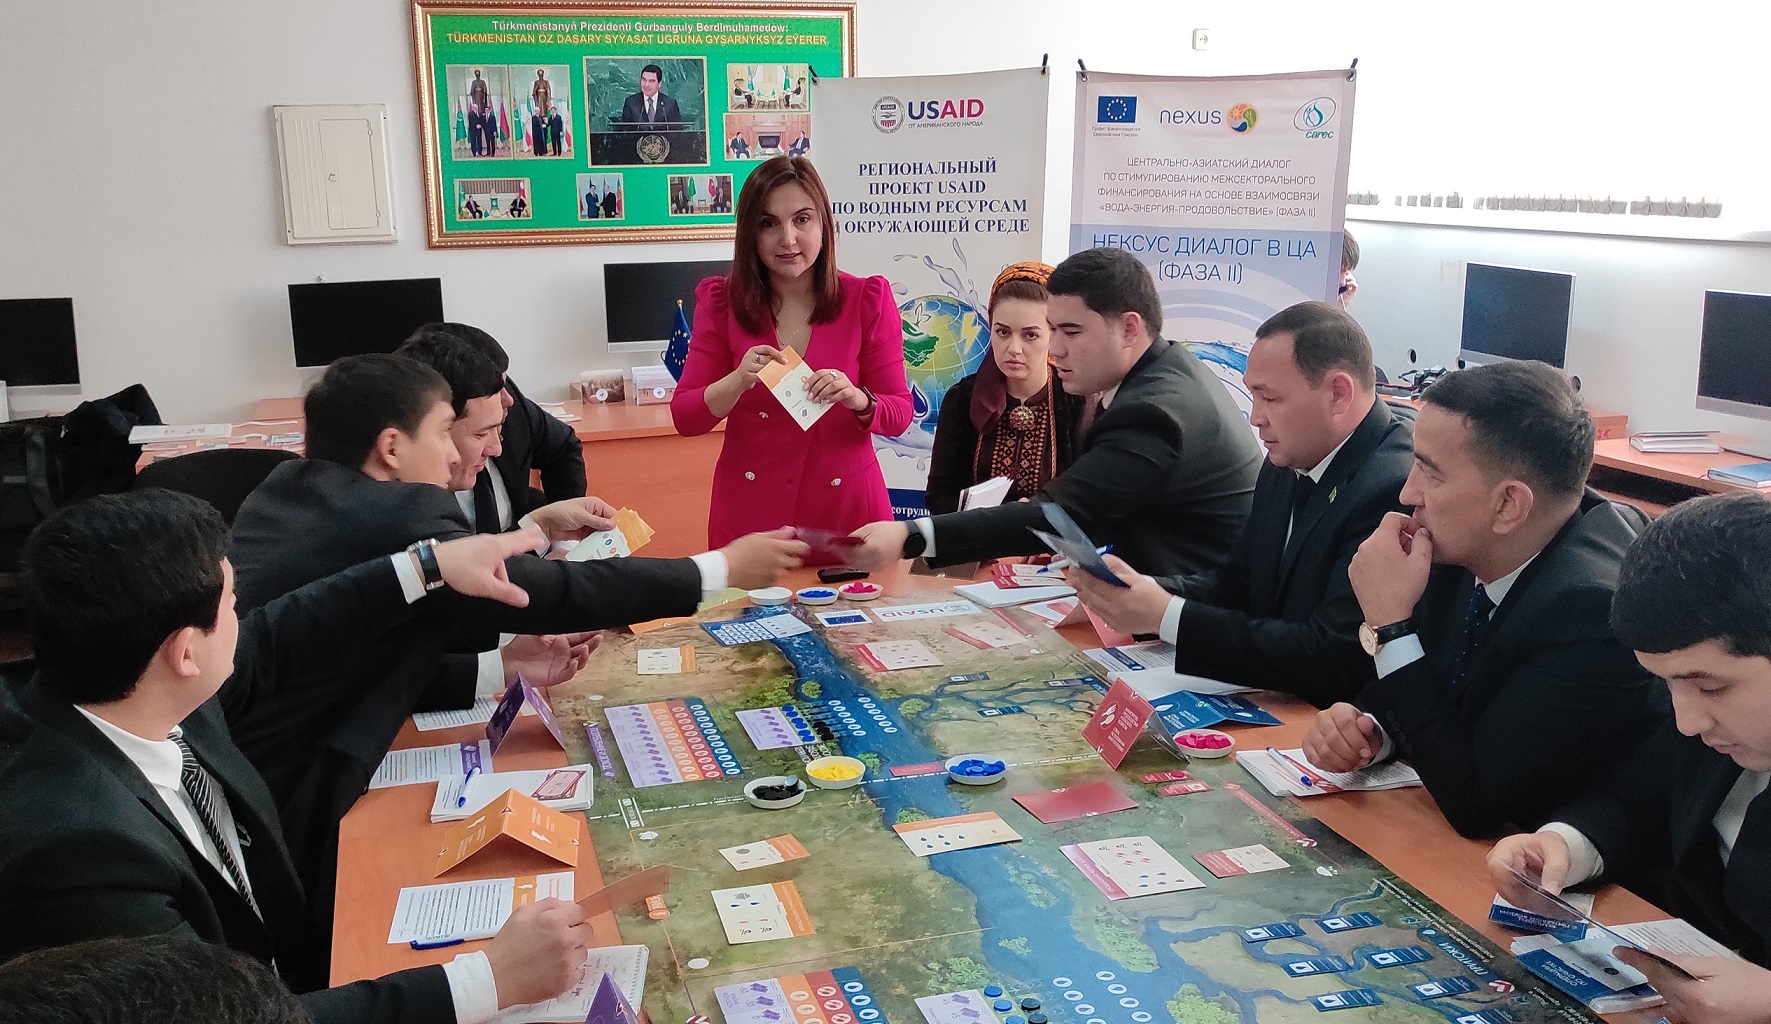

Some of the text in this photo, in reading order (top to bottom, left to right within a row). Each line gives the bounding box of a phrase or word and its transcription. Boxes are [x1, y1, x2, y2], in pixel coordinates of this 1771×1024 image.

[580, 21, 632, 32] Prezidenti
[634, 22, 693, 33] Gurbanguly
[447, 32, 535, 43] TÜRKMENISTAN
[657, 34, 703, 44] UGRUNA
[908, 99, 984, 121] USAID
[1159, 108, 1222, 125] nexus
[916, 121, 961, 129] АМЕРИКАНСКОГО
[1305, 130, 1334, 140] carec
[858, 157, 998, 176] РЕГИОНАЛЬНЫЙ
[1127, 157, 1292, 170] ЦЕНТРАЛЬНО-АЗИАТСКИЙ ДИАЛОГ
[1103, 172, 1316, 185] ПО СТИМУЛИРОВАНИЮ МЕЖСЕКТОРАЛЬНОГО
[868, 180, 986, 195] ПРОЕКТ USAID
[1097, 187, 1320, 202] ФИНАНСИРОВАНИЯ НА ОСНОВЕ ВЗАИМОСВЯЗИ
[832, 199, 1028, 216] ПО ВОДНЫМ РЕСУРСАМ
[1099, 202, 1274, 216] «ВОДА-ЭНЕРГИЯ-ПРОДОВОЛЬСТВИЕ»
[1276, 206, 1306, 217] (ФАЗА
[844, 216, 970, 235] ОКРУЖАЮЩЕЙ
[974, 219, 1030, 235] СРЕДЕ
[1092, 233, 1317, 261] НЕКСУС ДИАЛОГ В ЦА
[1158, 259, 1244, 285] (ФАЗА II)
[891, 506, 932, 518] сотрудн
[881, 608, 945, 618] USAID
[1438, 942, 1489, 975] ПРИТОКИ
